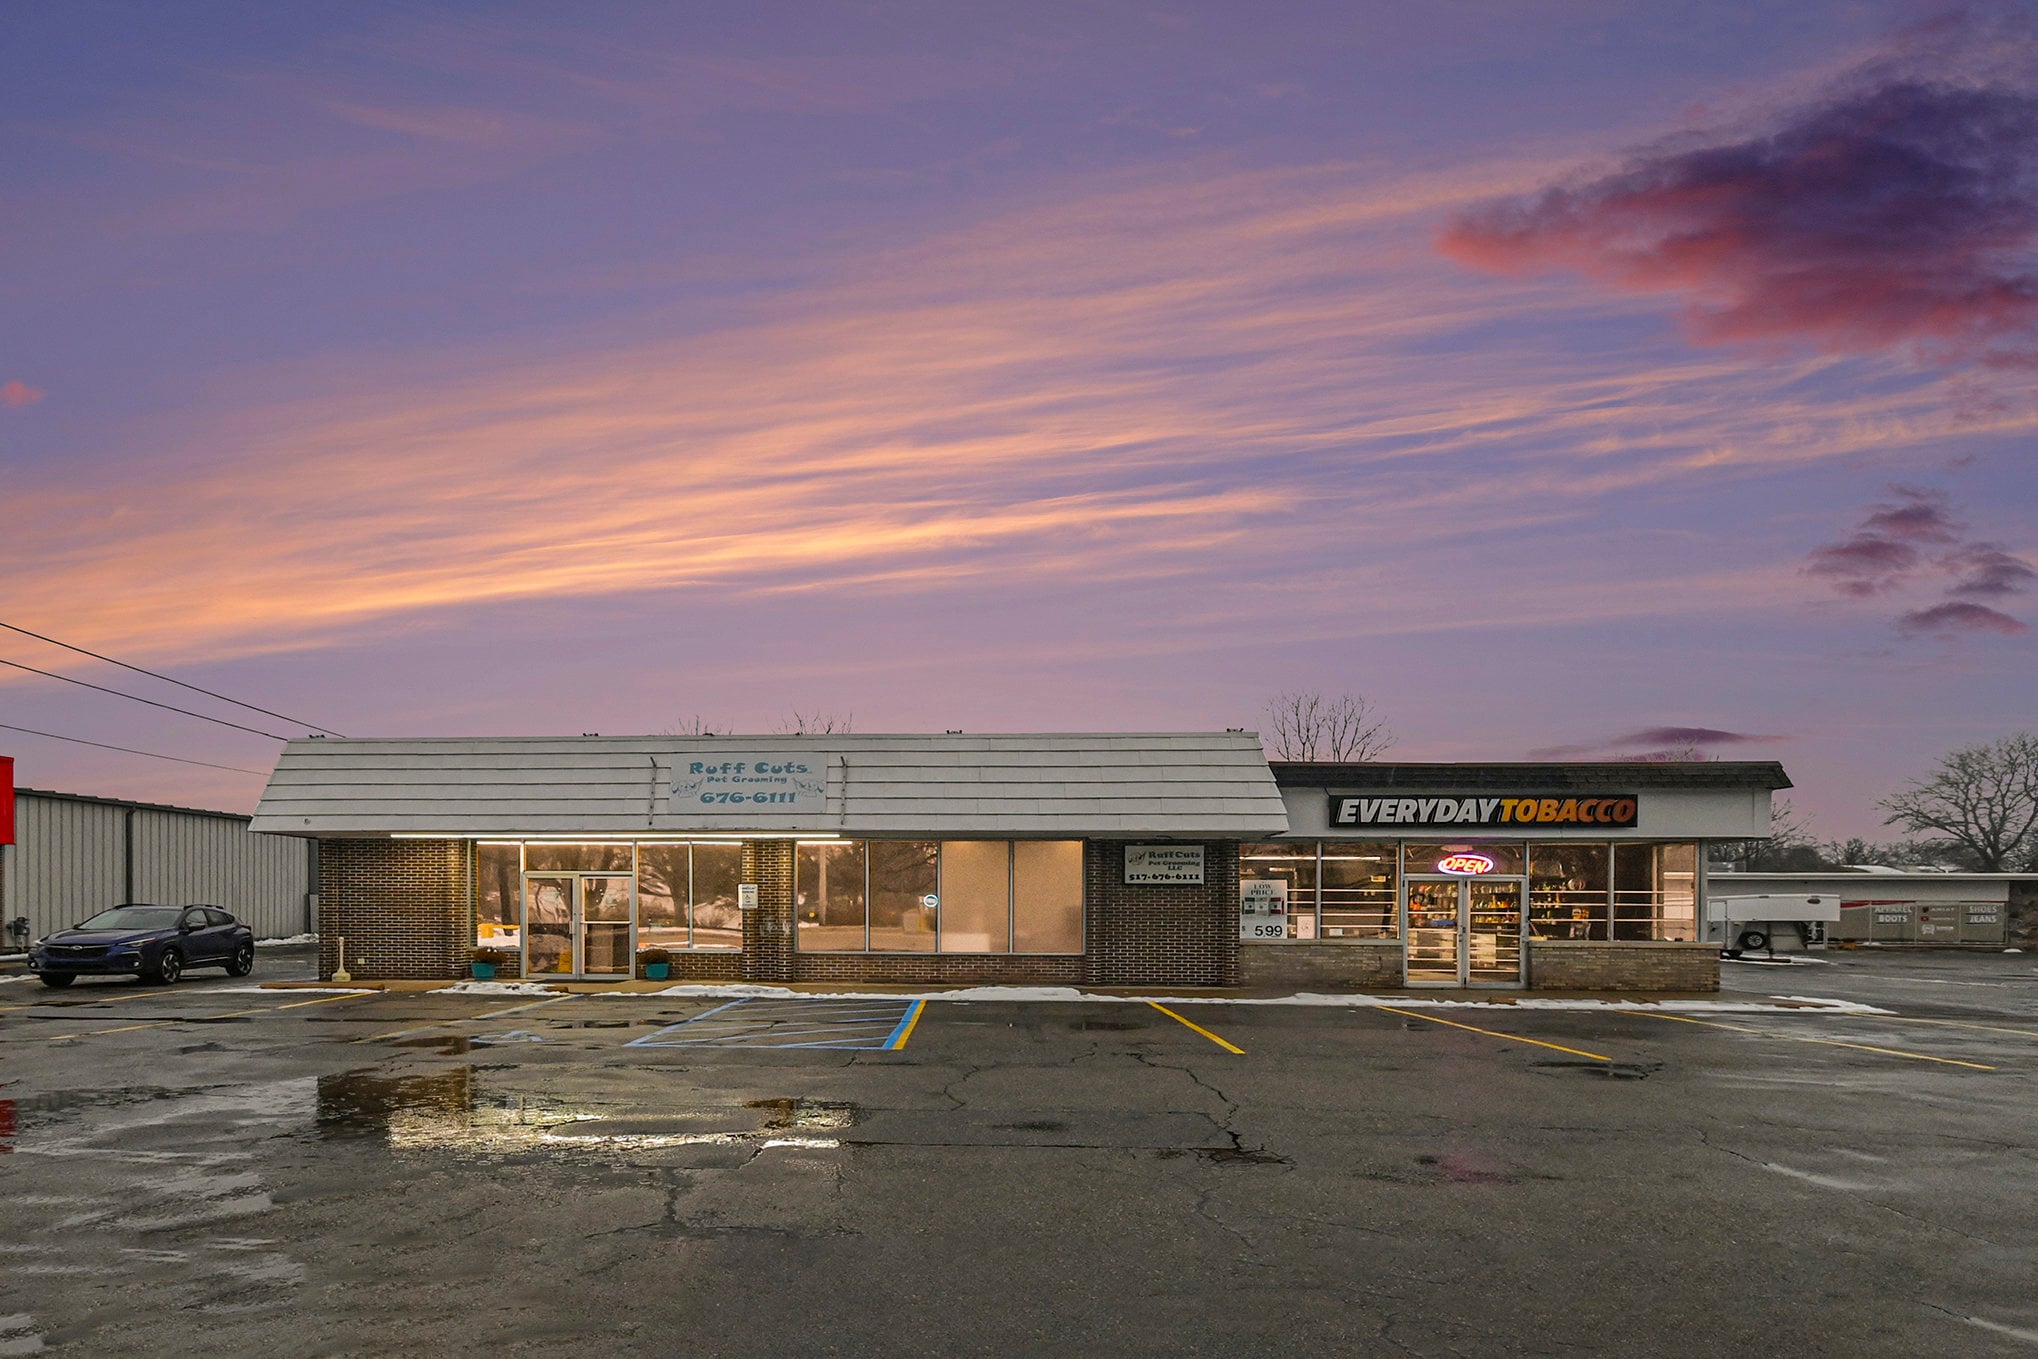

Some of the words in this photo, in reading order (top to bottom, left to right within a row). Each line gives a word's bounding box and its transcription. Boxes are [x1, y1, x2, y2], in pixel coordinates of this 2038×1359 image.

[689, 762, 746, 774] Ruff
[754, 761, 808, 774] Cuts
[732, 776, 787, 784] Grooming
[700, 792, 796, 804] 676-6111
[1148, 851, 1174, 859] Ruff
[1175, 851, 1200, 859] Cuts
[1443, 857, 1488, 874] OPEN
[1969, 905, 1998, 913] SHOES
[1878, 914, 1908, 923] BOOTS
[1969, 915, 1998, 923] JEANS
